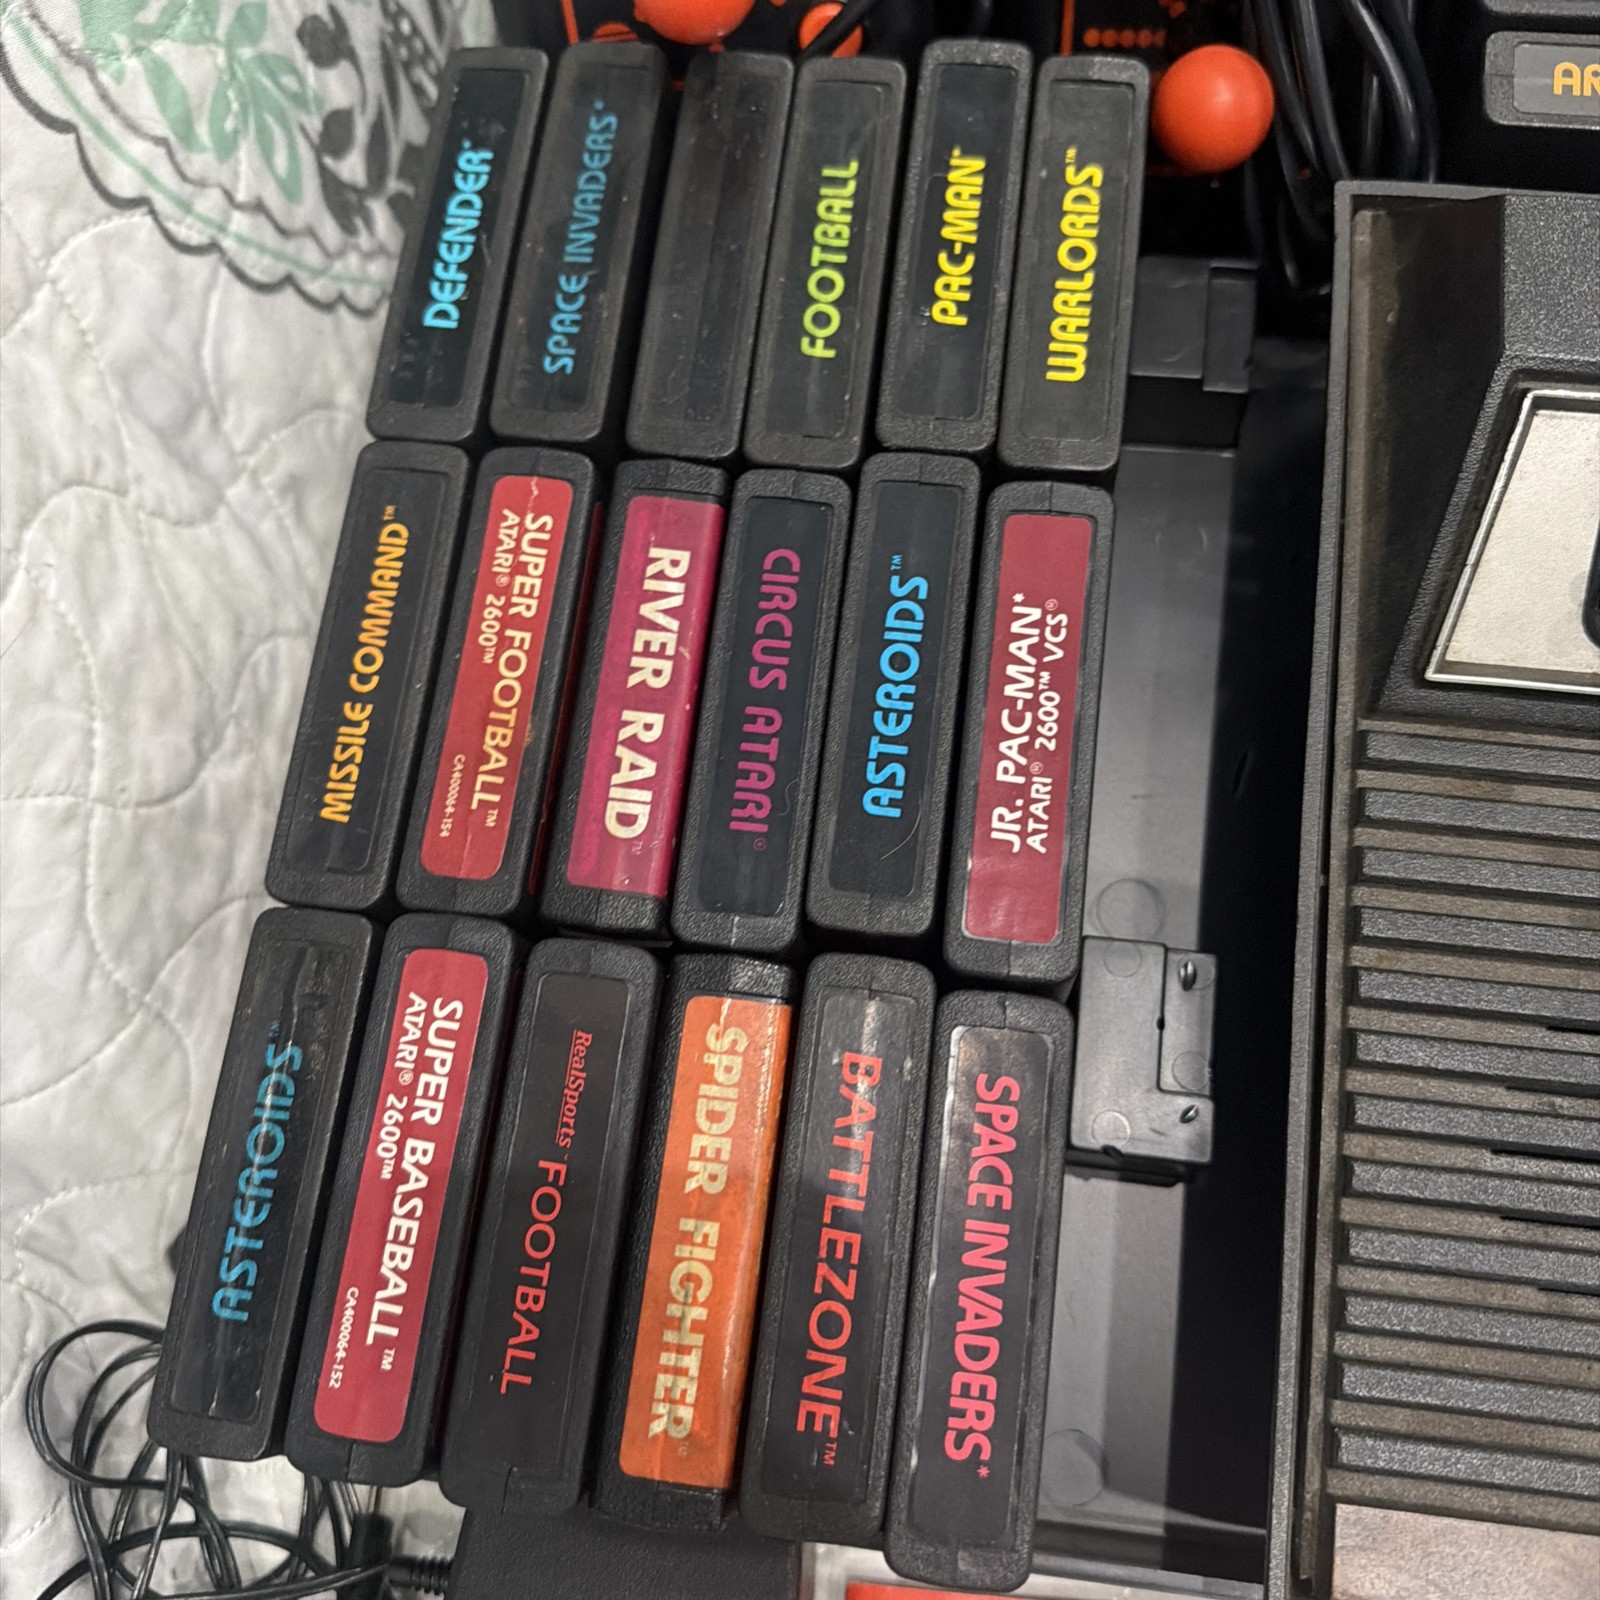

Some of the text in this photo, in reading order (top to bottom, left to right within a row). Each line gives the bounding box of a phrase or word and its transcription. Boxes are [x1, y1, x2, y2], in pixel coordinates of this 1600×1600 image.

[543, 274, 589, 376] SPACE
[801, 158, 859, 359] FOOTBALL
[507, 512, 553, 620] SUPER
[626, 546, 692, 689] RIVER
[748, 548, 800, 691] CIRCUS
[320, 701, 373, 824] MISSILE
[990, 798, 1025, 854] JR.
[411, 996, 463, 1127] SUPER
[684, 1024, 749, 1195] SPIDER
[967, 1072, 1021, 1211] SPACE
[327, 1286, 360, 1389] CA400064-152
[500, 1159, 567, 1395] FOOTBALL
